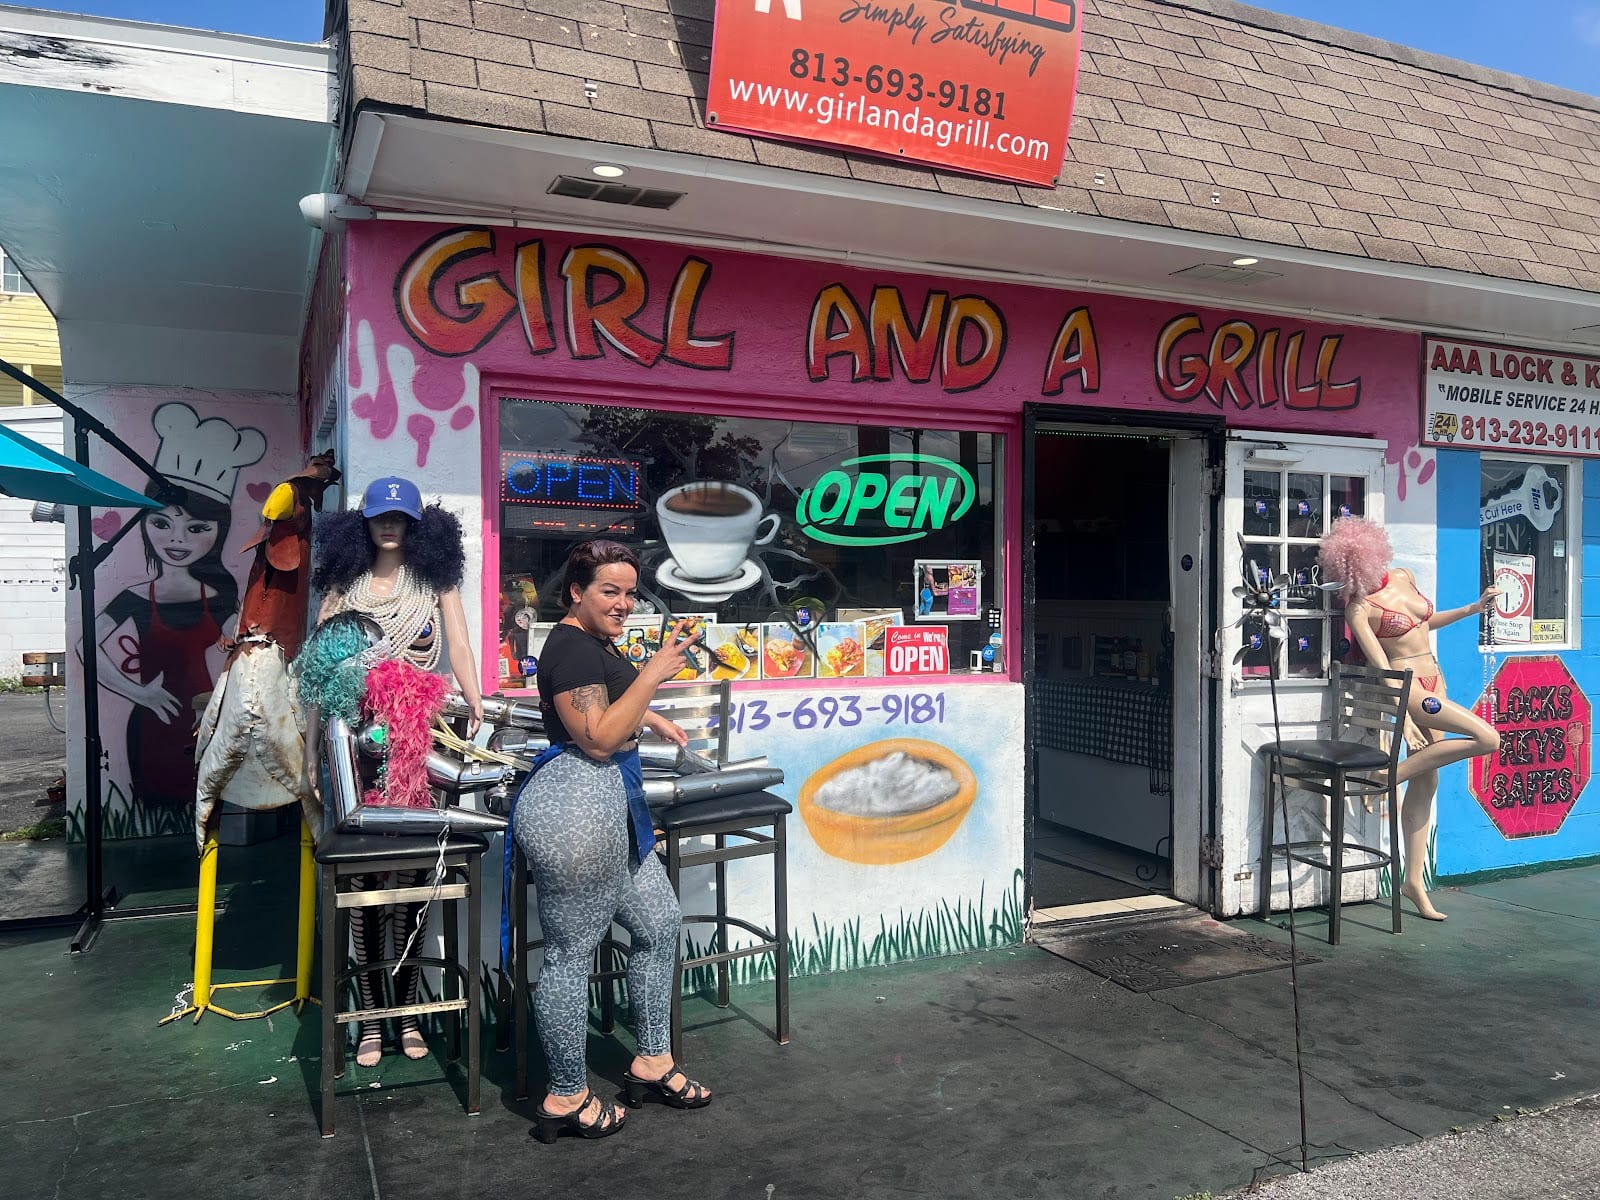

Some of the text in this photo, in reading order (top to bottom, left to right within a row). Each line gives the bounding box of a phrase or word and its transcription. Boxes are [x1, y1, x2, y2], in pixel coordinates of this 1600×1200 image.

[839, 0, 928, 45] Simply
[930, 6, 1046, 78] Satisfying
[790, 48, 1006, 120] 813-693-9181
[728, 78, 1050, 161] www.girlandagrill.com
[392, 224, 1364, 411] GIRL AND A GRILL
[1431, 345, 1484, 376] AAA
[1490, 351, 1554, 384] LOCK
[1560, 361, 1578, 387] &
[1434, 415, 1451, 429] 24
[1505, 391, 1567, 412] SERVICE
[1569, 398, 1586, 415] 24
[1589, 400, 1600, 416] H
[1461, 414, 1600, 450] 813-232-9111
[507, 461, 635, 500] OPEN
[808, 470, 958, 530] OPEN
[1485, 506, 1500, 520] Cut
[1500, 502, 1522, 516] Here
[1482, 517, 1520, 551] PEN
[891, 631, 912, 643] Come
[890, 645, 944, 673] OPEN
[1493, 684, 1574, 724] LOCKS
[1499, 727, 1568, 766] KEYS
[1490, 767, 1575, 811] SAFES
